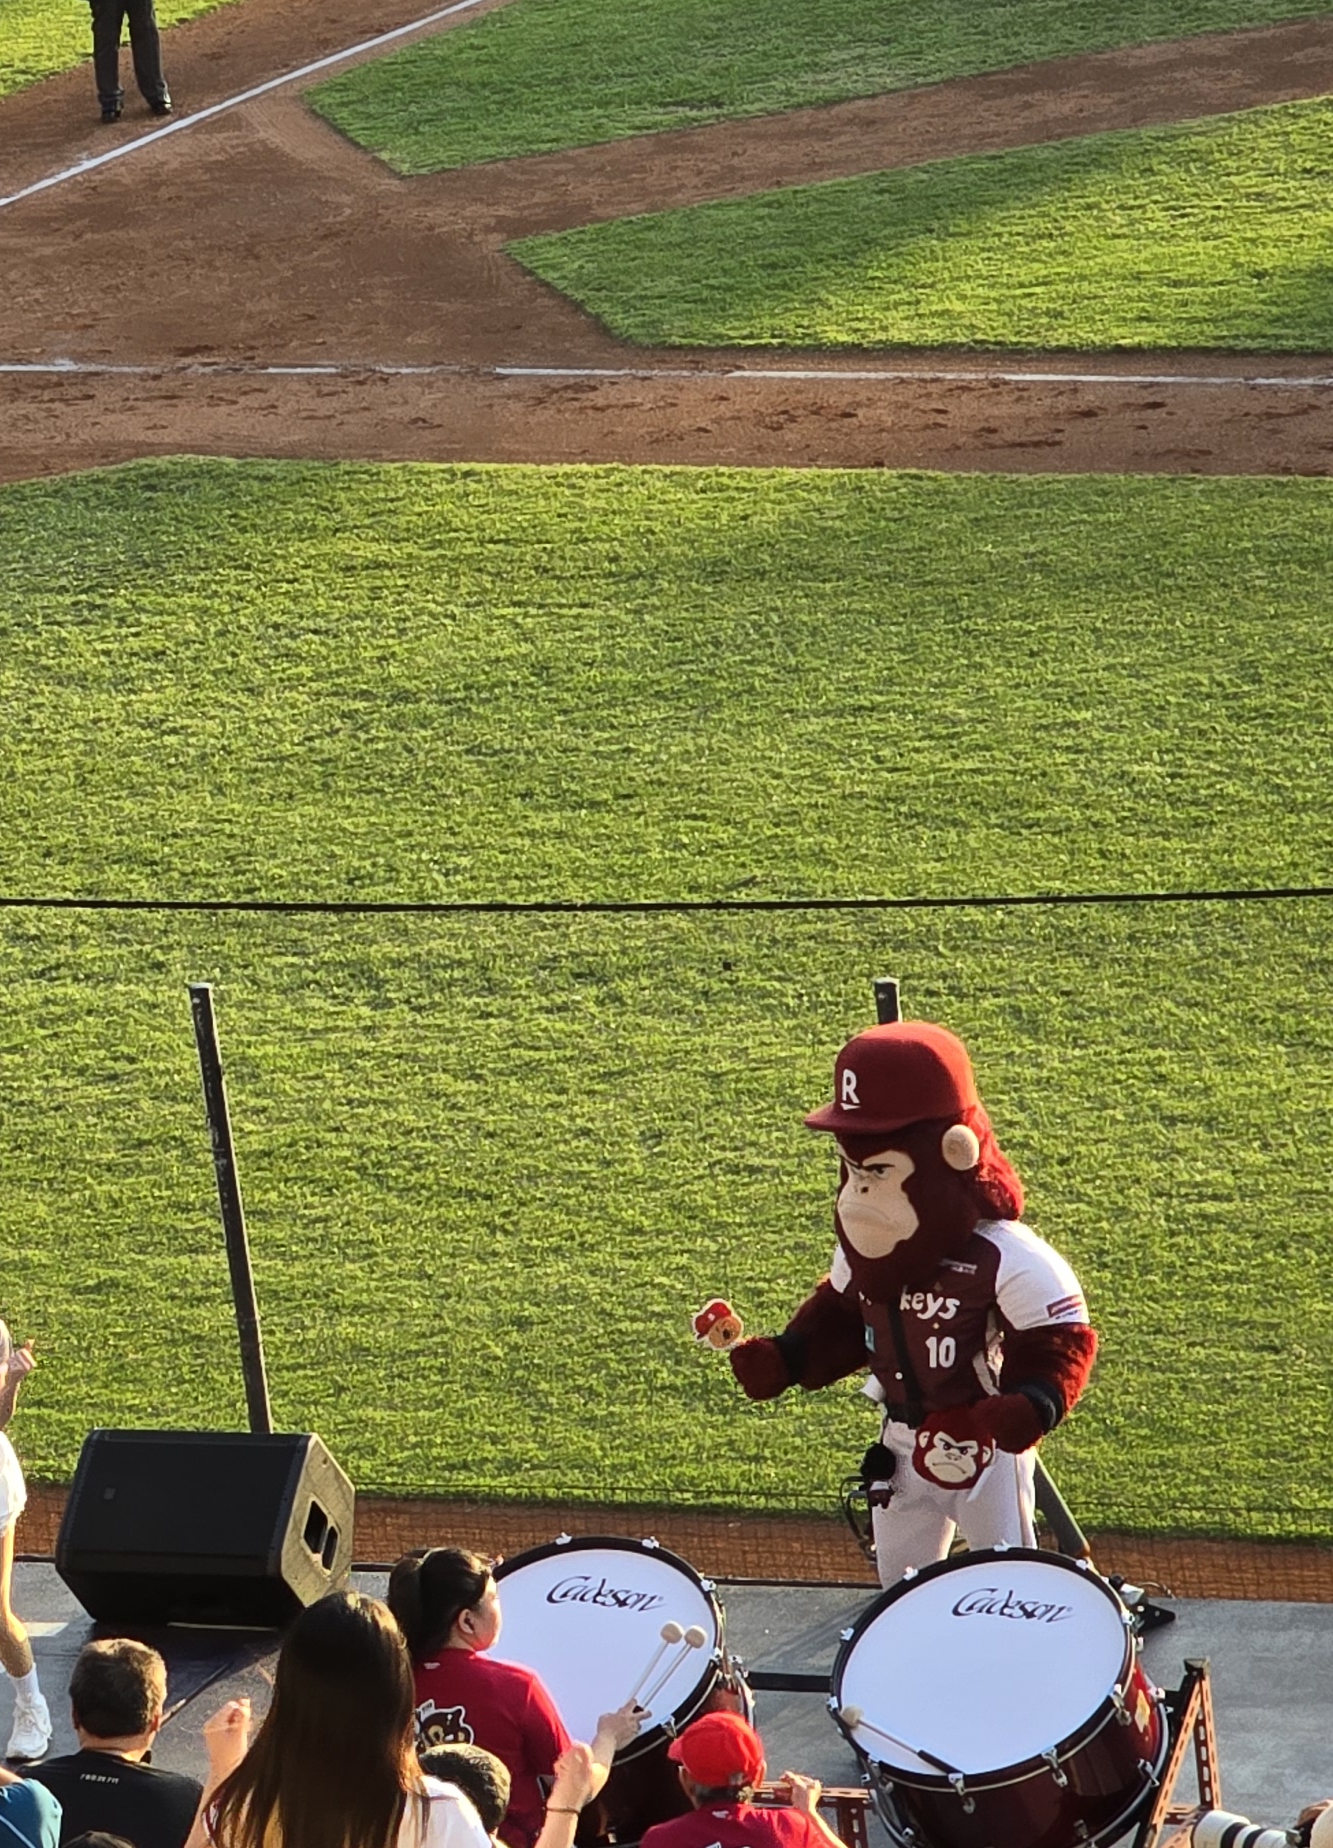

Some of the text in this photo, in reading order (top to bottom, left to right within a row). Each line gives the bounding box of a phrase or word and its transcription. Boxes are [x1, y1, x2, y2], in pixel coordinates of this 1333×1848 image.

[842, 1069, 860, 1103] R
[899, 1284, 961, 1320] keys
[925, 1336, 956, 1368] 10
